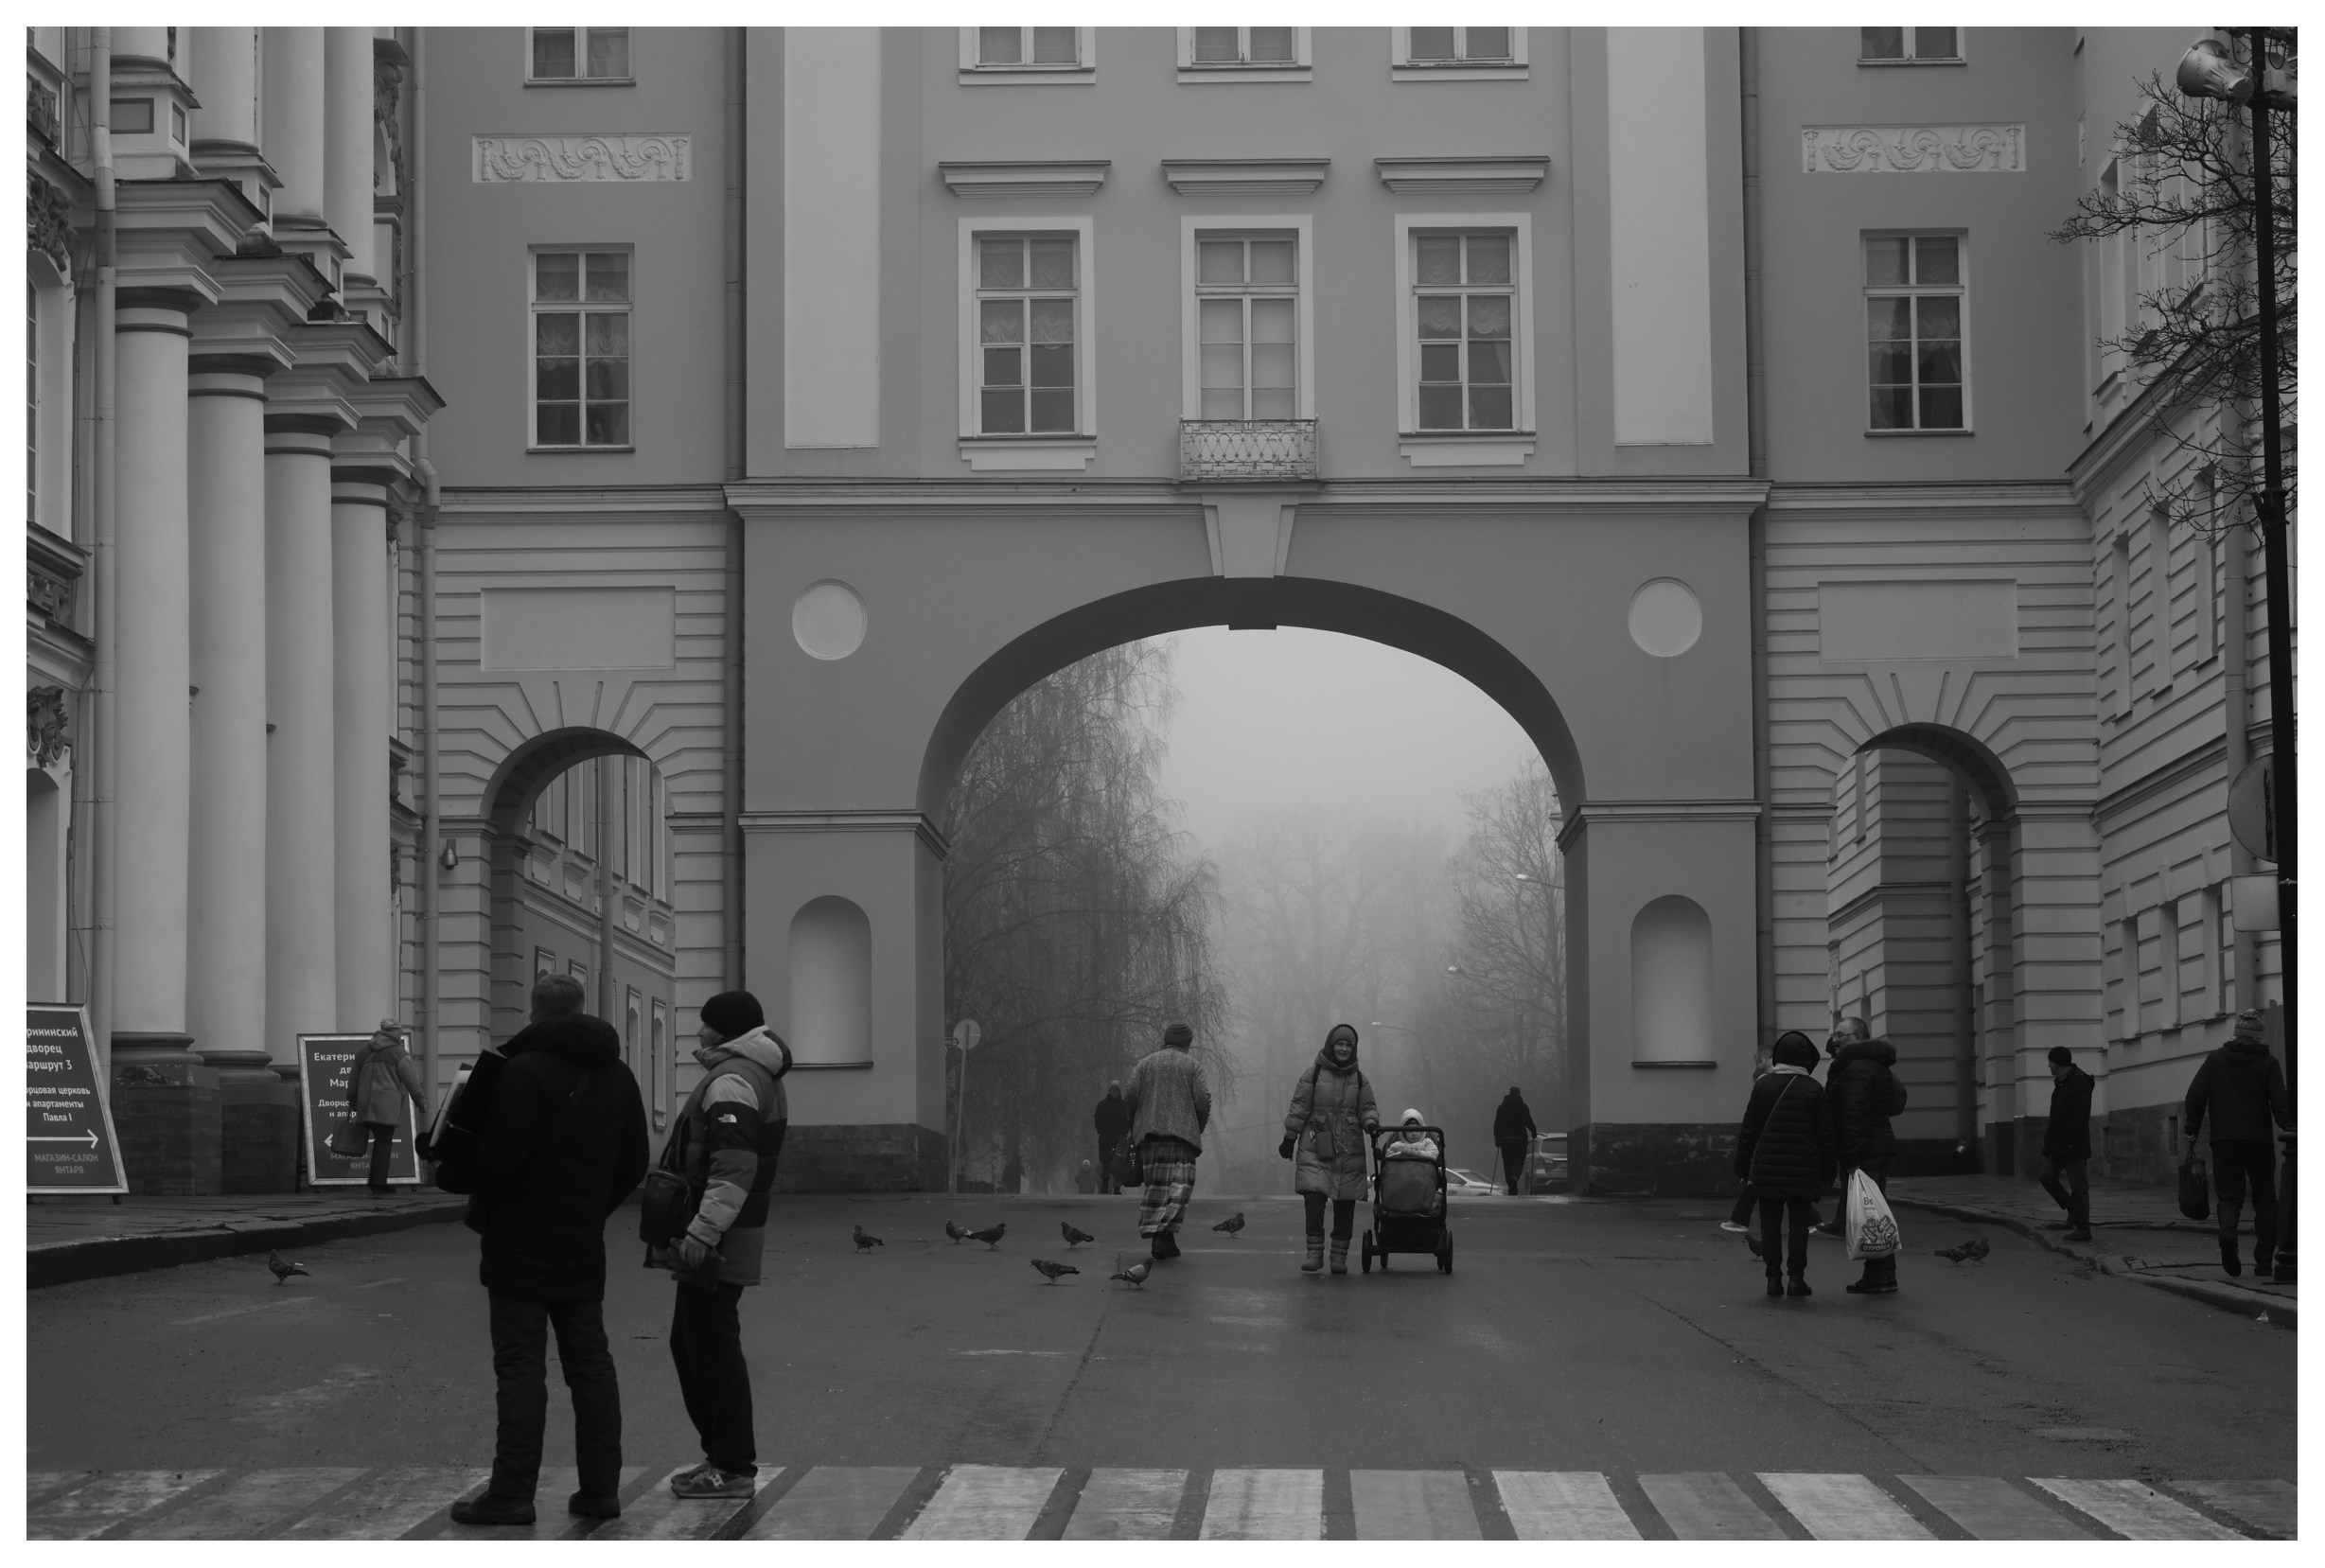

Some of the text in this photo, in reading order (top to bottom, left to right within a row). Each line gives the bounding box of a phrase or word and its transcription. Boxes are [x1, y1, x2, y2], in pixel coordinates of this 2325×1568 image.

[26, 1027, 79, 1038] рининский
[26, 1045, 62, 1055] дворец
[313, 1052, 356, 1063] Екатери
[26, 1059, 73, 1072] аршрут 3
[339, 1066, 352, 1075] дв
[329, 1078, 349, 1089] Мар
[58, 1087, 91, 1097] церковь
[32, 1101, 84, 1110] апартаменты
[318, 1099, 350, 1108] Дворцо
[43, 1112, 67, 1121] Павла
[34, 1154, 99, 1162] МАГАЗИН-САЛОН
[54, 1165, 84, 1174] ЯНТАРЯ
